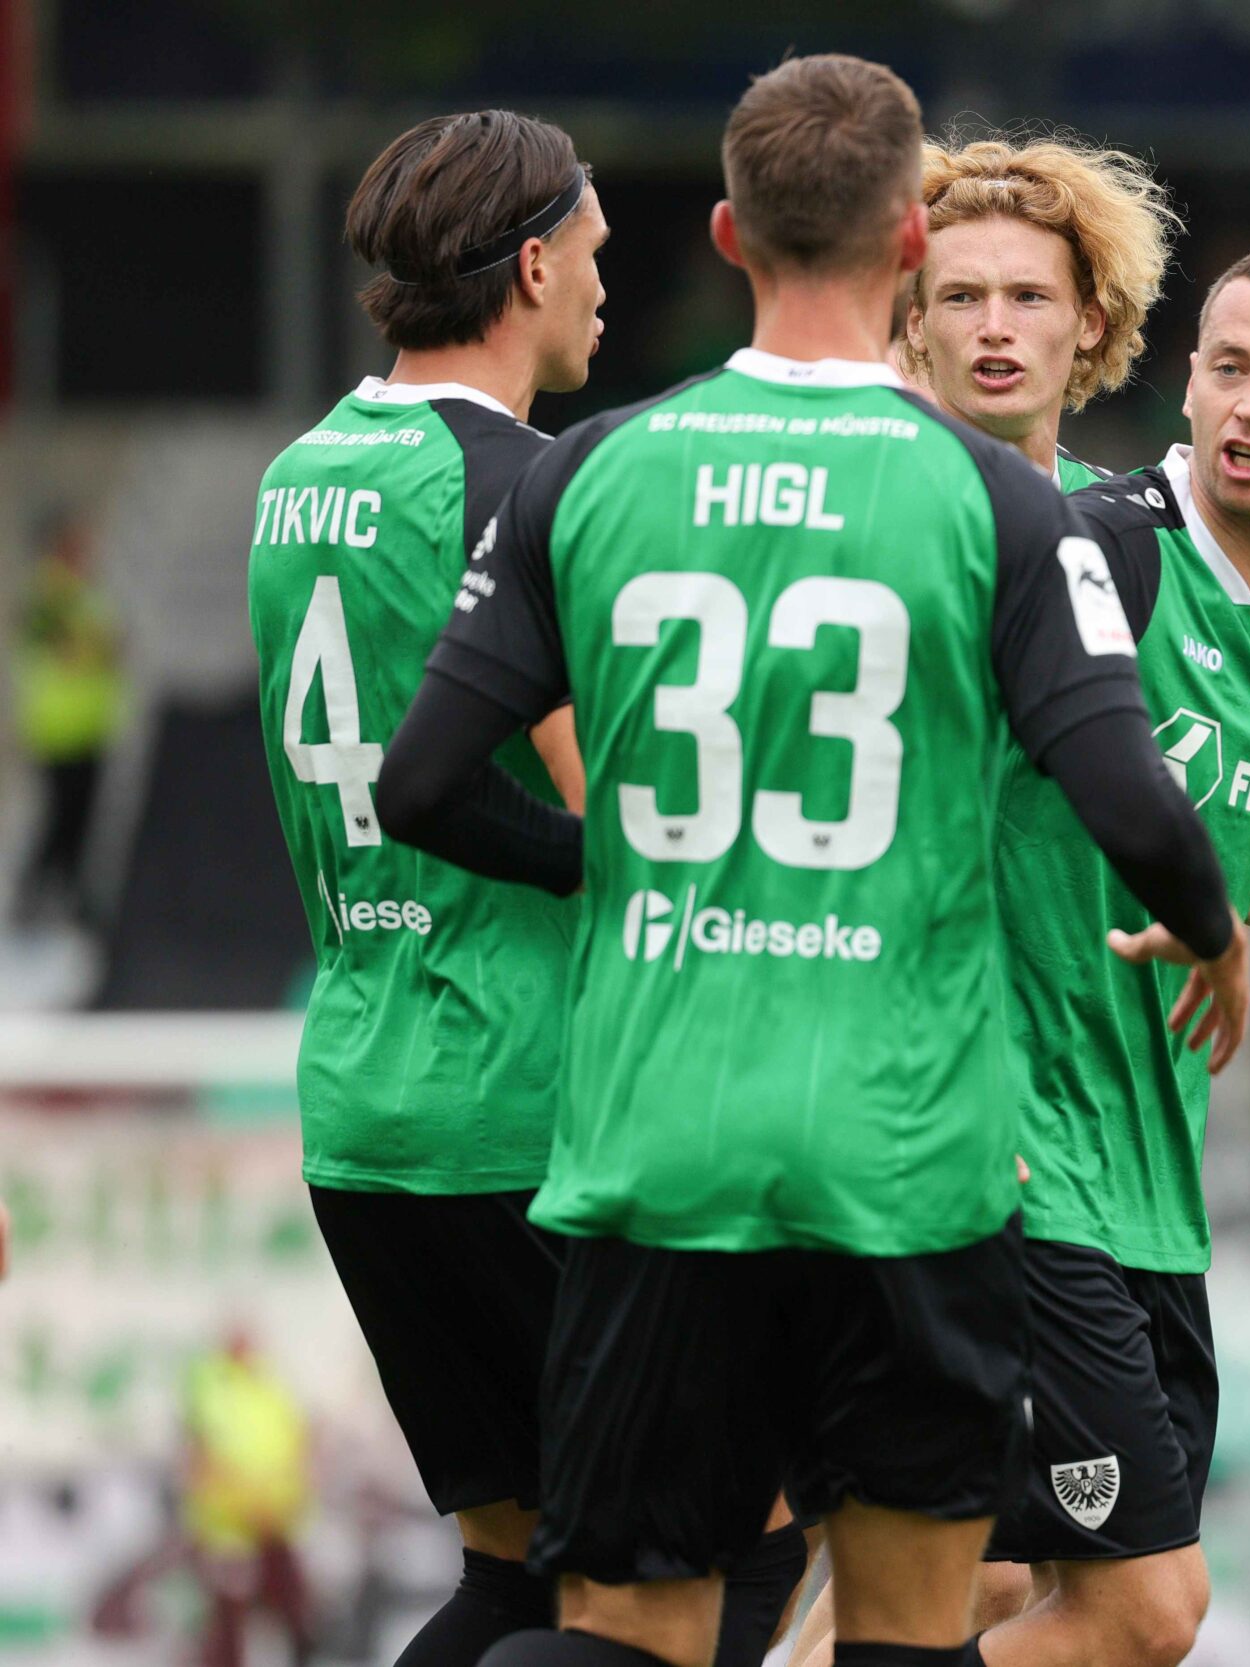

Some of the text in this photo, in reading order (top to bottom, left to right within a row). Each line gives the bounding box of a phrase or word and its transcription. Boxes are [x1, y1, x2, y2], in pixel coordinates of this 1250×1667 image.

[254, 486, 382, 549] TIKVIC
[693, 462, 845, 531] HIGL
[1183, 634, 1224, 673] JAKO
[283, 575, 384, 848] 4
[611, 570, 911, 871] 33
[690, 906, 882, 962] Gieseke
